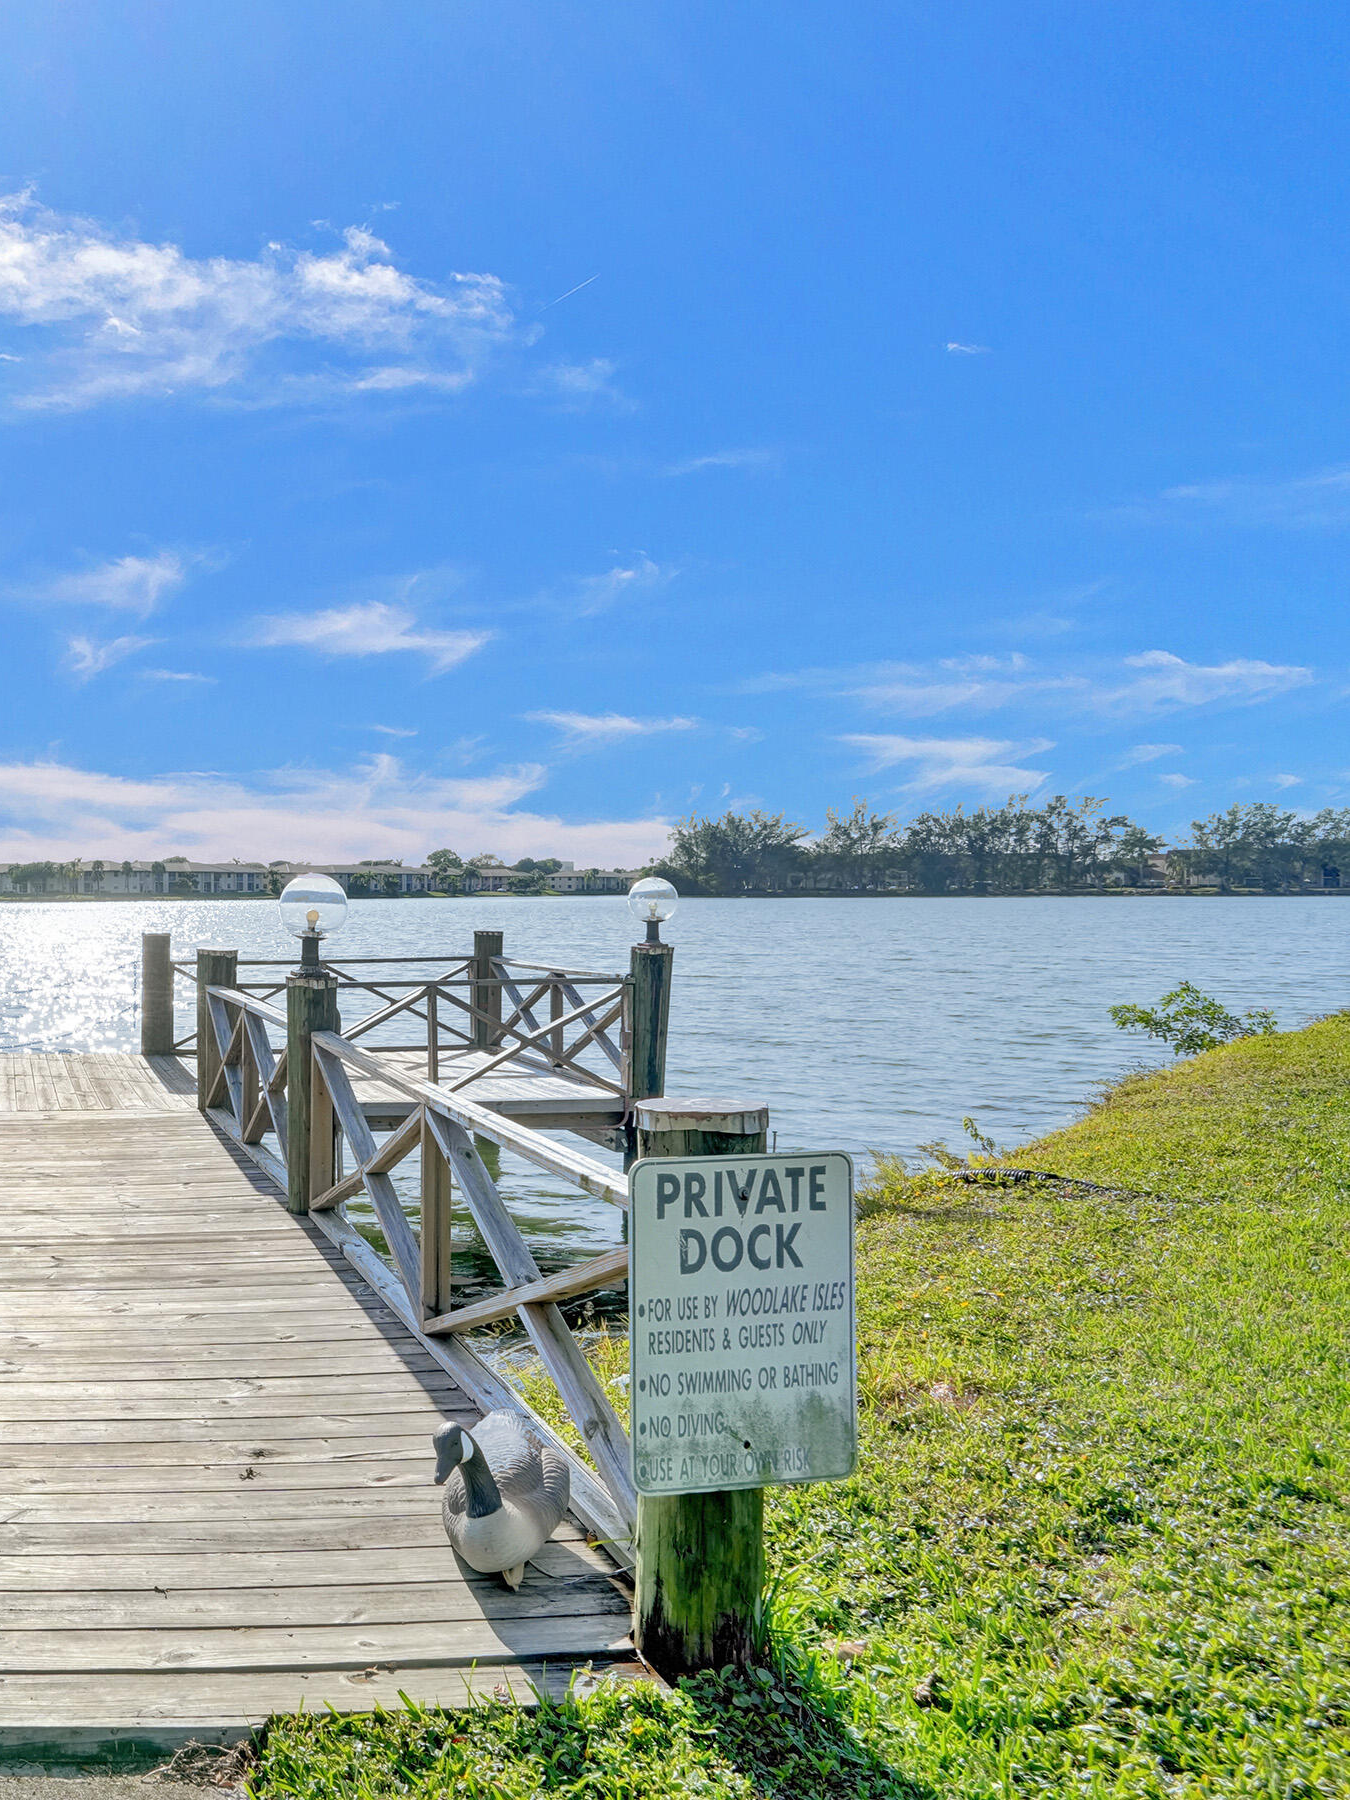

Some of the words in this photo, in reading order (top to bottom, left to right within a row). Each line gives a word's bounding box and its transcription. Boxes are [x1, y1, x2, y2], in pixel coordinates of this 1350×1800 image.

[656, 1166, 827, 1220] PRIVATE
[679, 1222, 803, 1274] DOCK
[648, 1299, 671, 1322] FOR
[678, 1296, 698, 1321] USE
[704, 1295, 718, 1318] BY
[726, 1284, 808, 1317] WOODLAKE
[812, 1282, 845, 1311] ISLES
[648, 1328, 715, 1354] RESIDENTS
[722, 1329, 731, 1350] &
[739, 1323, 785, 1348] GUESTS
[792, 1320, 827, 1345] ONLY
[649, 1374, 671, 1397] NO
[678, 1368, 752, 1395] SWIMMING
[758, 1367, 777, 1389] OR
[784, 1362, 839, 1388] BATHING
[649, 1416, 671, 1438] NO
[678, 1412, 725, 1437] DIVING
[650, 1458, 673, 1481] USE
[680, 1456, 694, 1479] AT
[701, 1452, 738, 1478] YOUR
[744, 1448, 778, 1473] OWN
[783, 1448, 810, 1471] RISK
